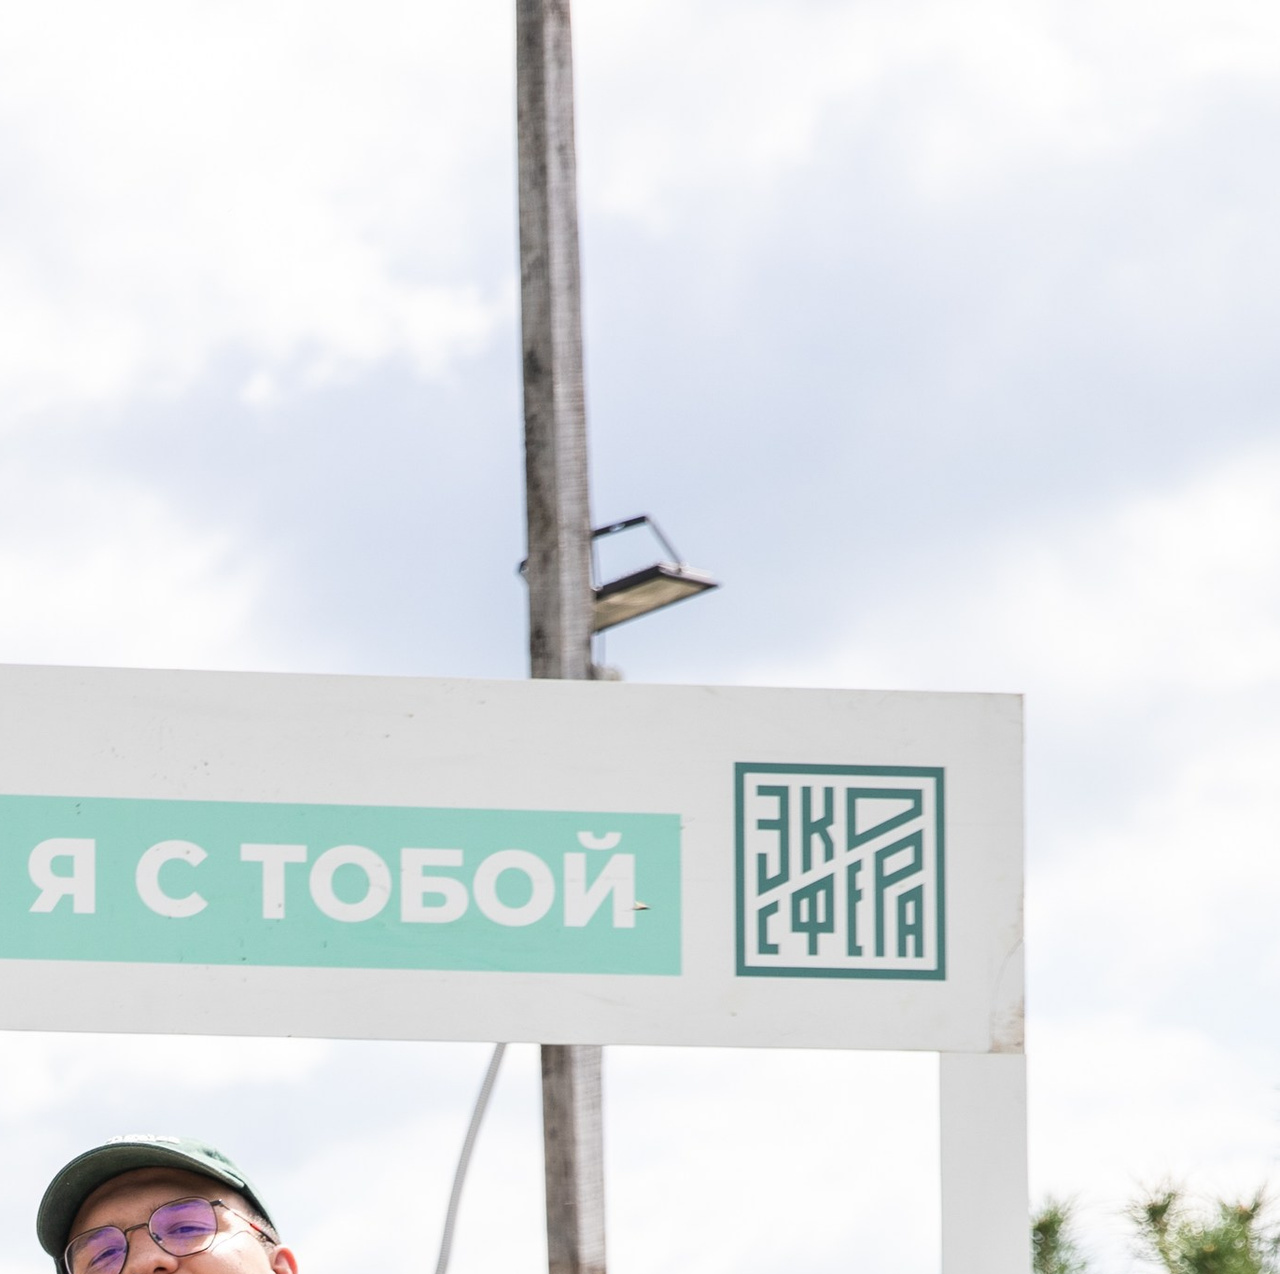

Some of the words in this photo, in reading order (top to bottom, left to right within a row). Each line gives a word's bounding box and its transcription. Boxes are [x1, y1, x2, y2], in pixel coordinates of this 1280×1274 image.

[28, 837, 96, 914] Я
[135, 840, 208, 918] С
[240, 831, 638, 929] ТОБОЙ
